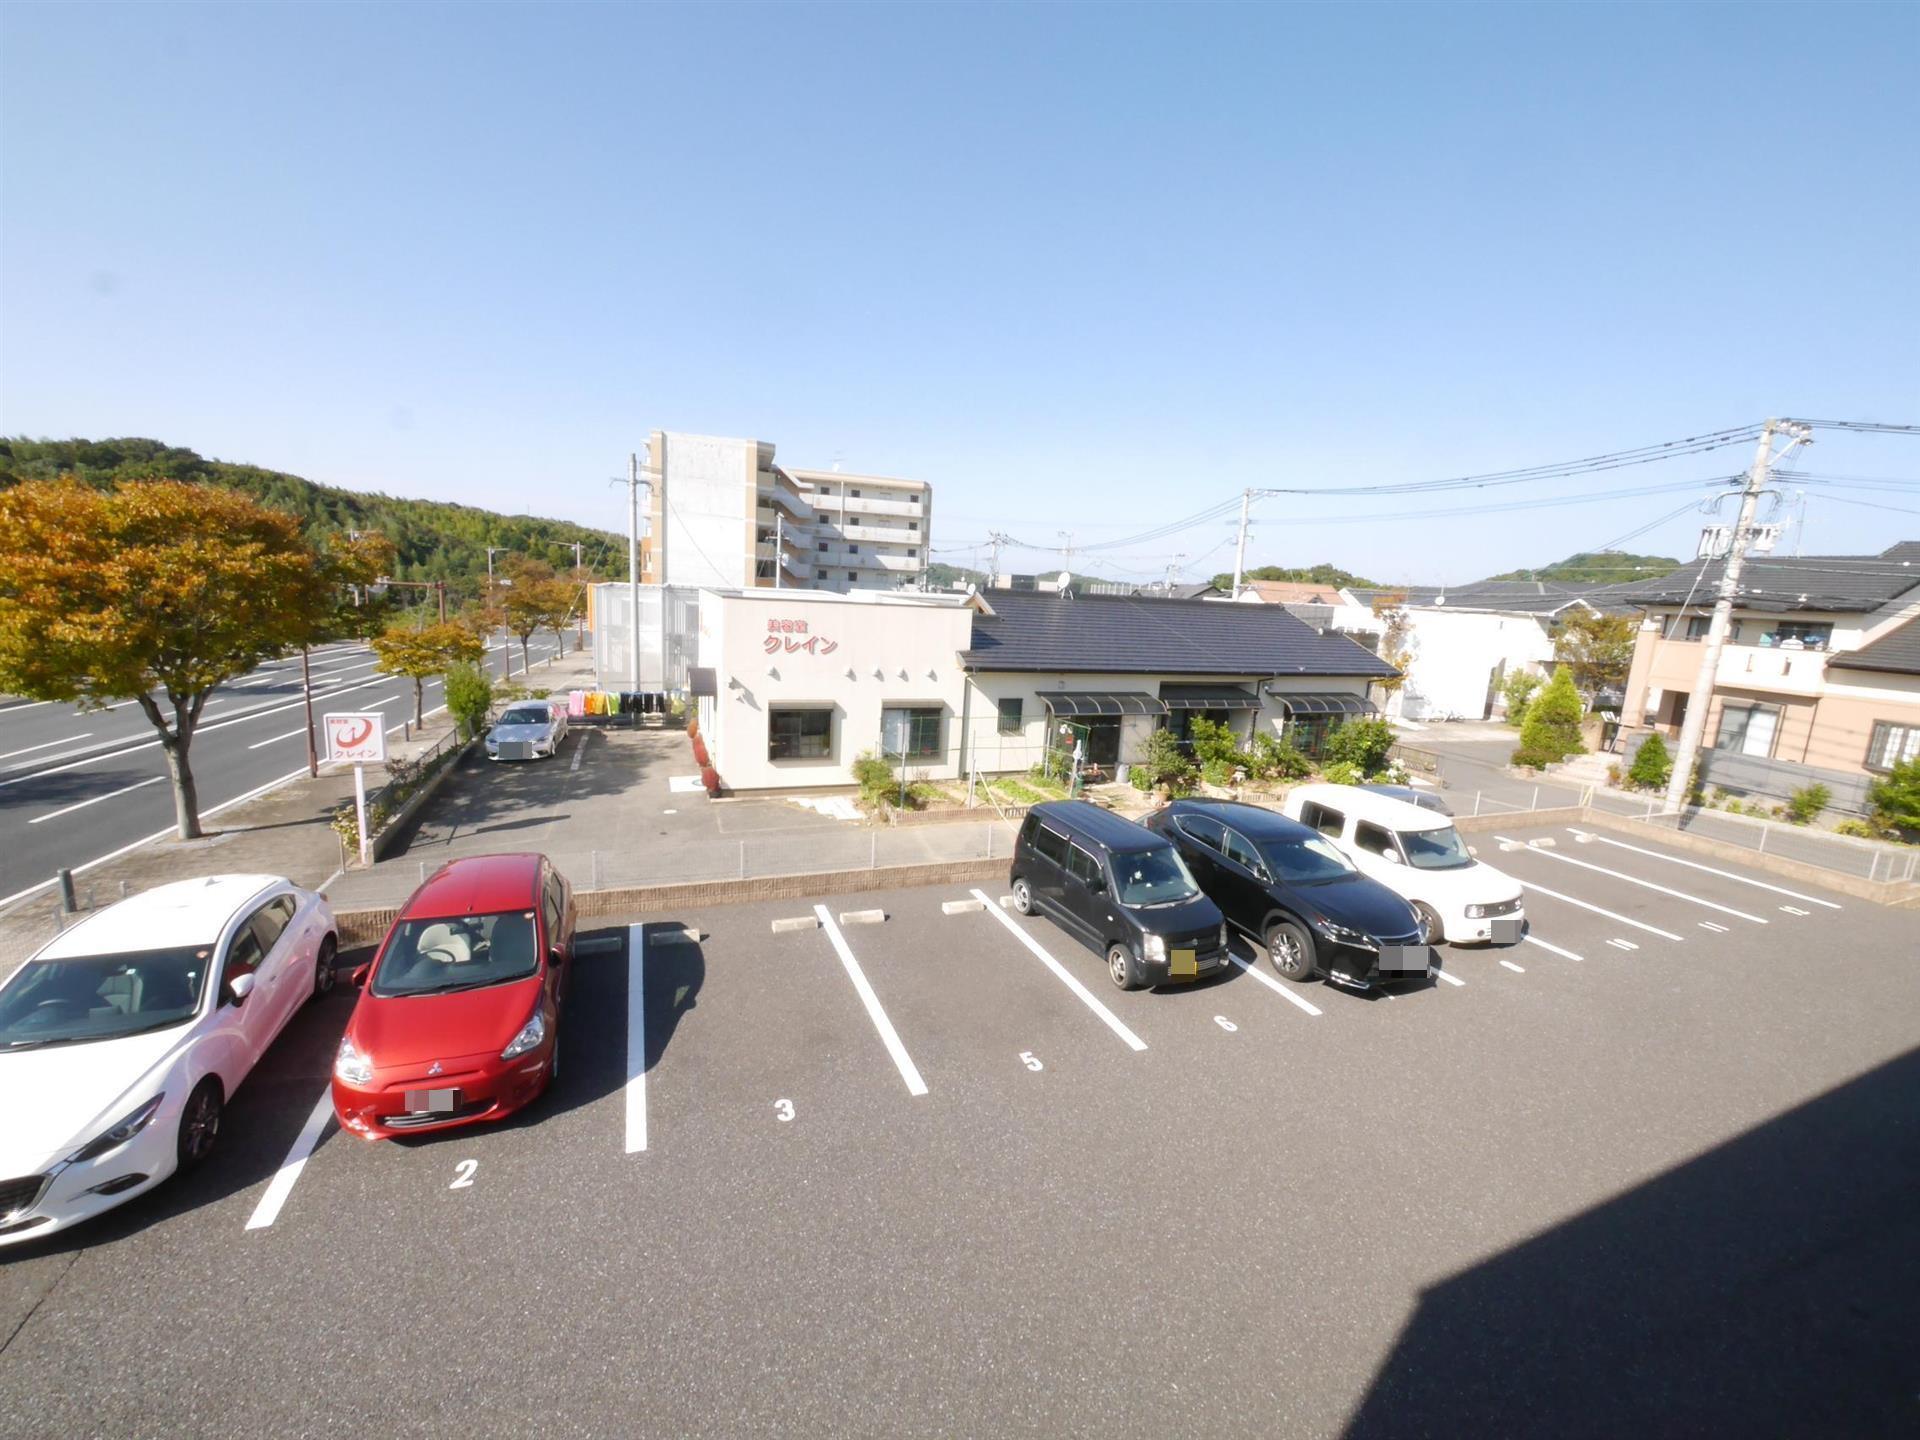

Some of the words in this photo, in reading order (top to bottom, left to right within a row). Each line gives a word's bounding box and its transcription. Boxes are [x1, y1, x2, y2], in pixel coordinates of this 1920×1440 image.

[763, 634, 838, 655] クレイン
[335, 749, 377, 759] クレイン
[1214, 1015, 1238, 1032] 6
[1019, 1051, 1043, 1071] 5
[774, 1099, 795, 1121] 3
[449, 1159, 478, 1189] 2
